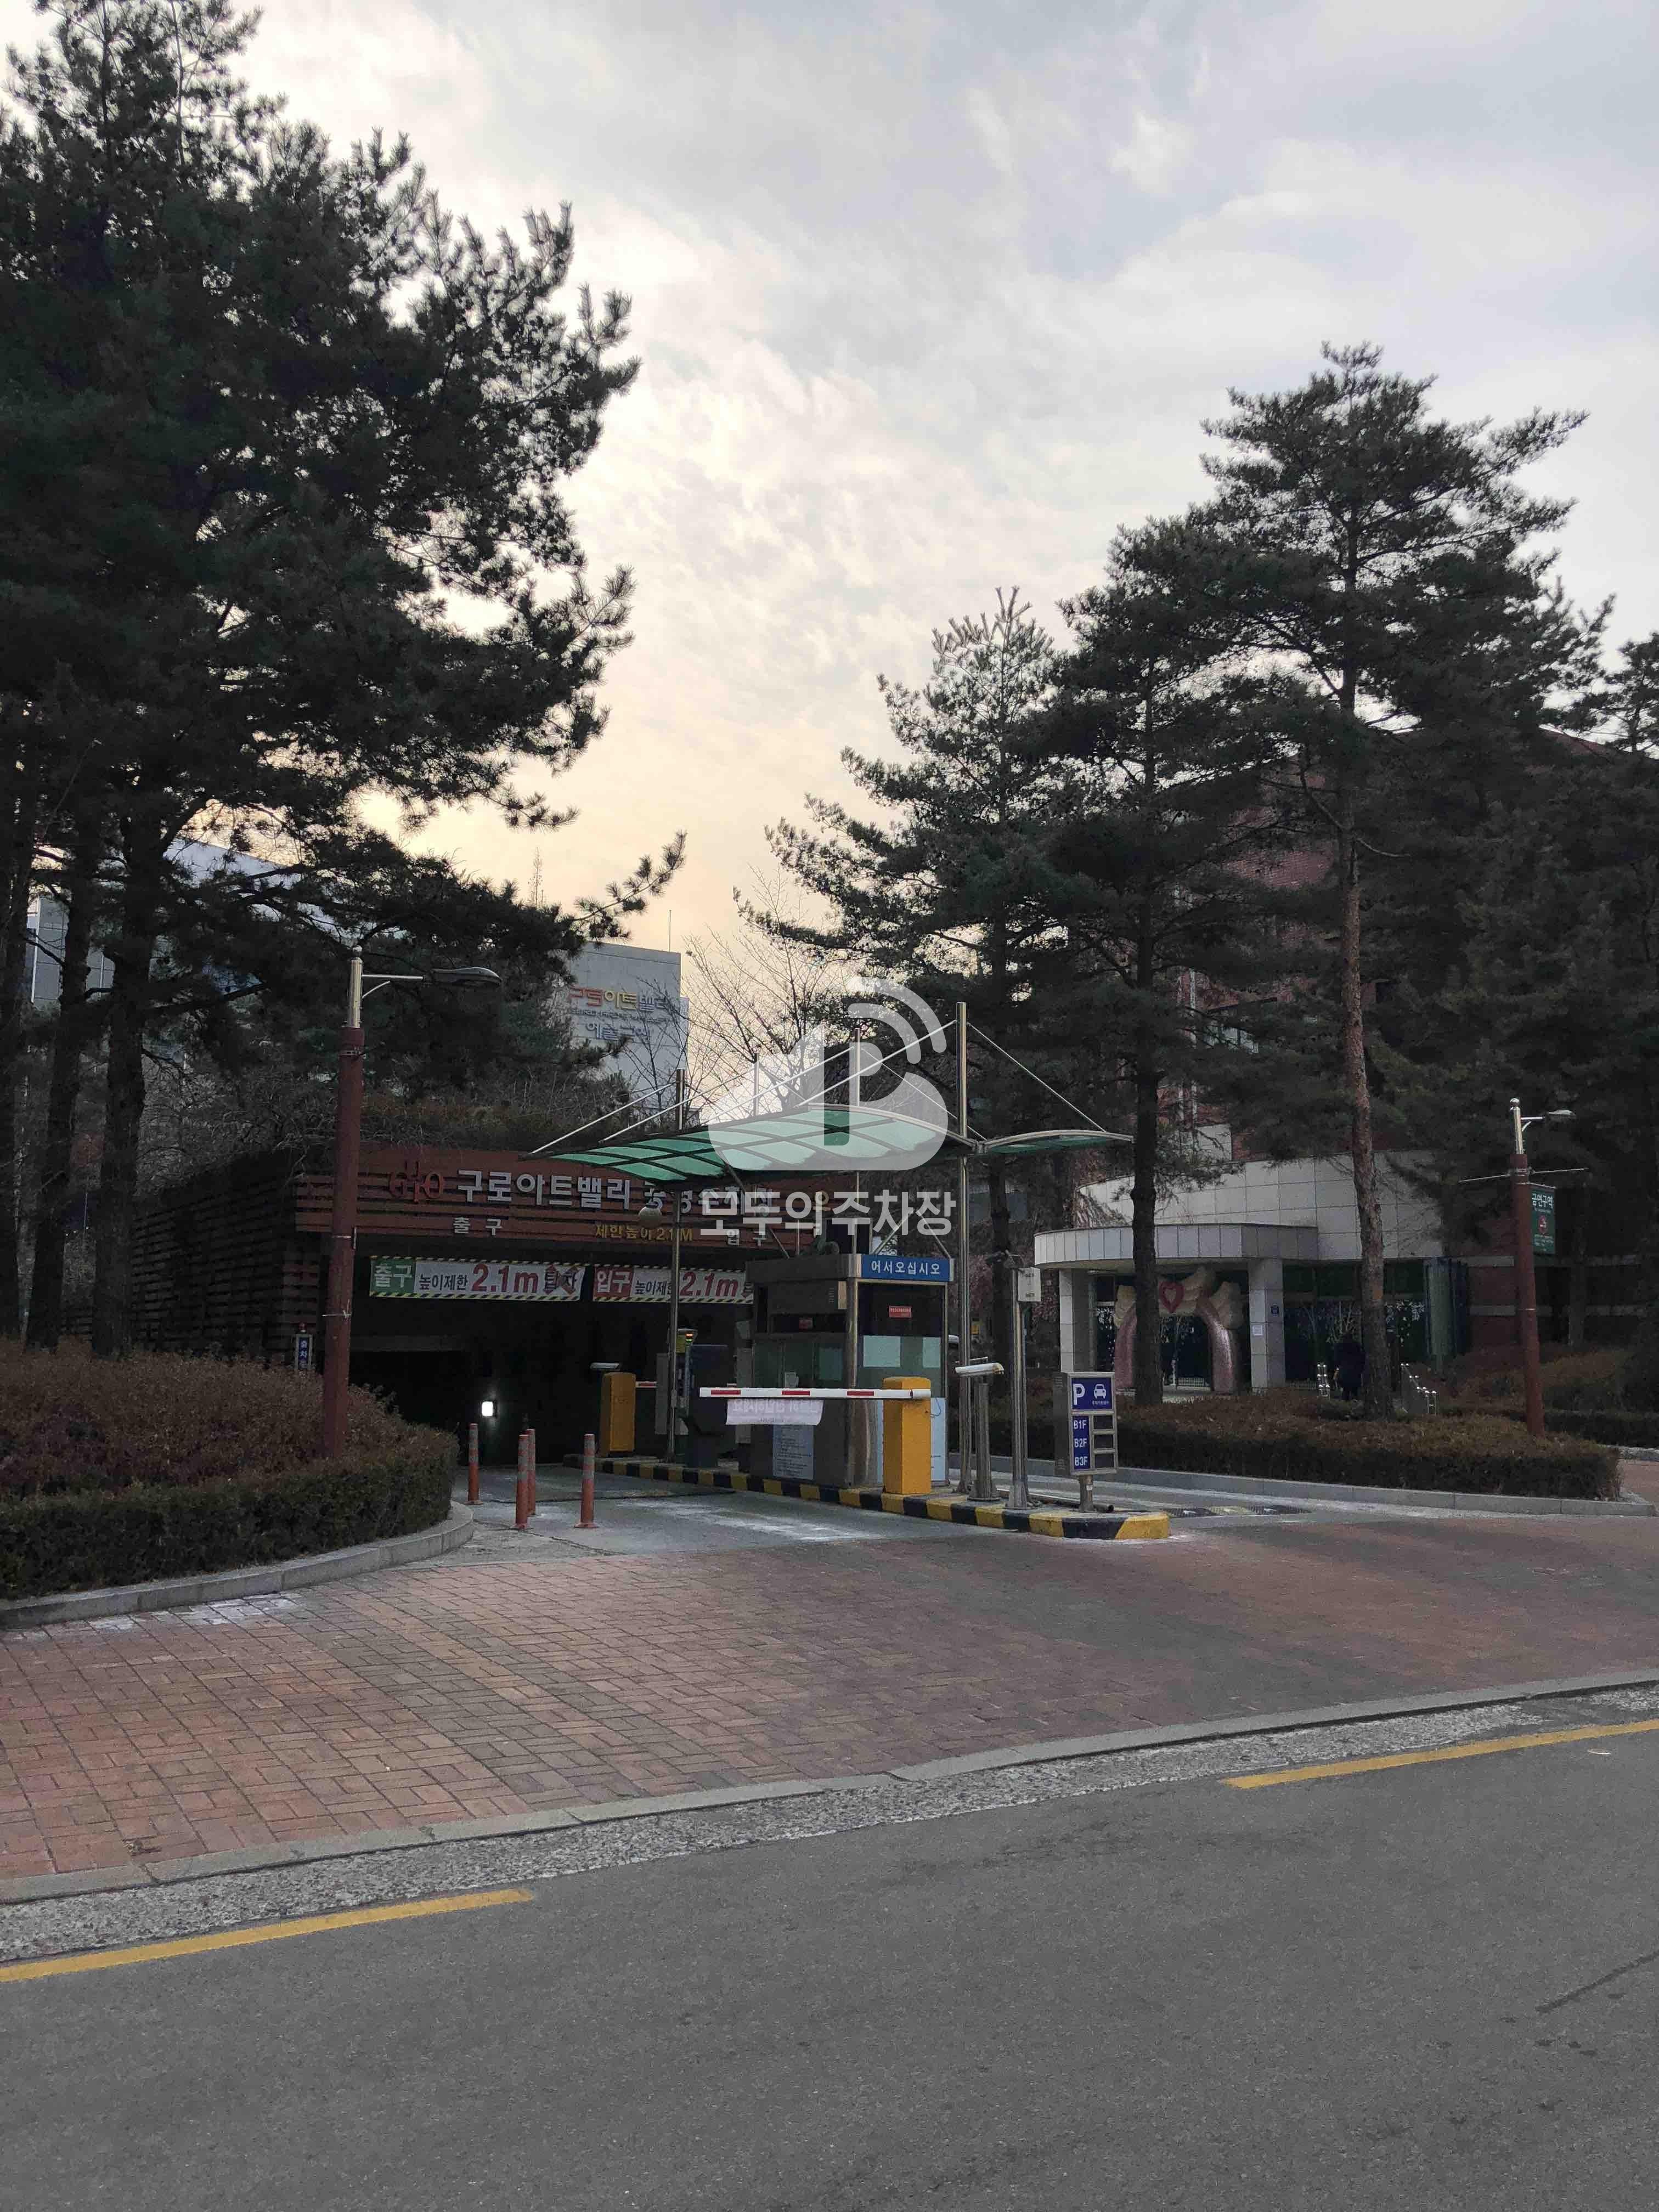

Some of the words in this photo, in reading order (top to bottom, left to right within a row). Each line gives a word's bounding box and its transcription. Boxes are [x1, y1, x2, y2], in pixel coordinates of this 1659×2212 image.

[457, 1169, 631, 1211] 구로아트밸리
[871, 1260, 940, 1276] 어서오십시오
[374, 1263, 413, 1289] 출구
[419, 1273, 468, 1291] 높이제한
[471, 1263, 539, 1294] 2.1m
[596, 1269, 631, 1294] 입구
[679, 1271, 738, 1297] 2.1m
[1073, 1384, 1085, 1406] P
[1074, 1420, 1087, 1430] B1F
[1074, 1438, 1087, 1448] B2F
[1075, 1456, 1088, 1466] B3F
